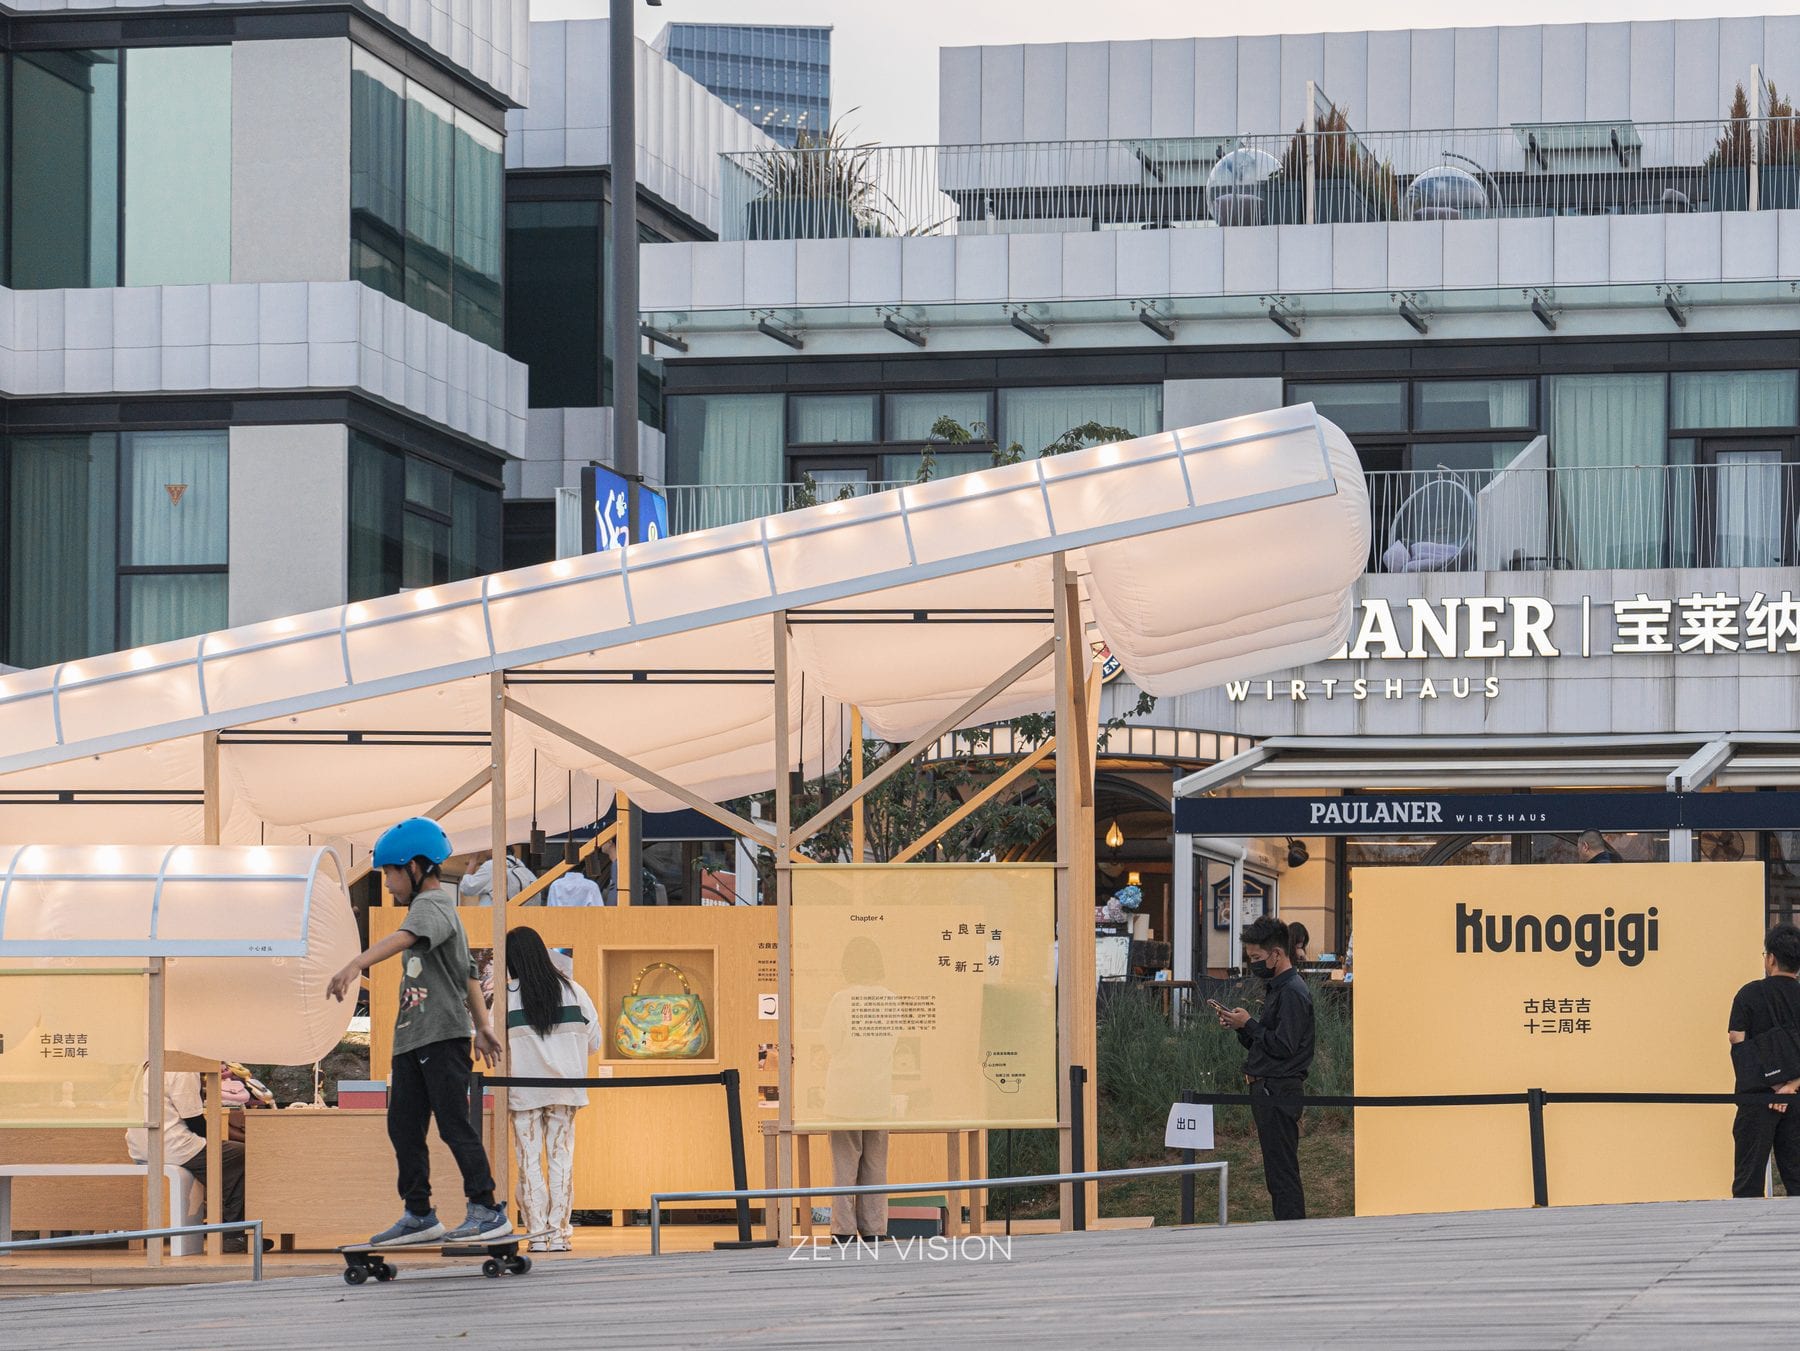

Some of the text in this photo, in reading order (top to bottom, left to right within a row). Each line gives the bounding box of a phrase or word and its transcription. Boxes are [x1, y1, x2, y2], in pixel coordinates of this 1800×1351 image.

[1327, 597, 1560, 659] ANER
[1613, 591, 1800, 654] 宝莱纳
[1226, 677, 1500, 702] WIRTSHAUS
[1310, 802, 1547, 824] PAULANER WIRTSHAUS
[850, 914, 885, 923] Chapter 4
[941, 923, 1002, 941] 古良吉吉
[1456, 903, 1658, 967] kunogigi
[758, 942, 778, 950] 古良吉
[938, 955, 1000, 973] 玩新工坊
[1523, 998, 1591, 1014] 古良吉吉
[1523, 1018, 1592, 1034] 十三周年
[40, 1033, 88, 1045] 古良吉吉
[40, 1046, 88, 1058] 十三周年
[1176, 1117, 1196, 1130] 出口
